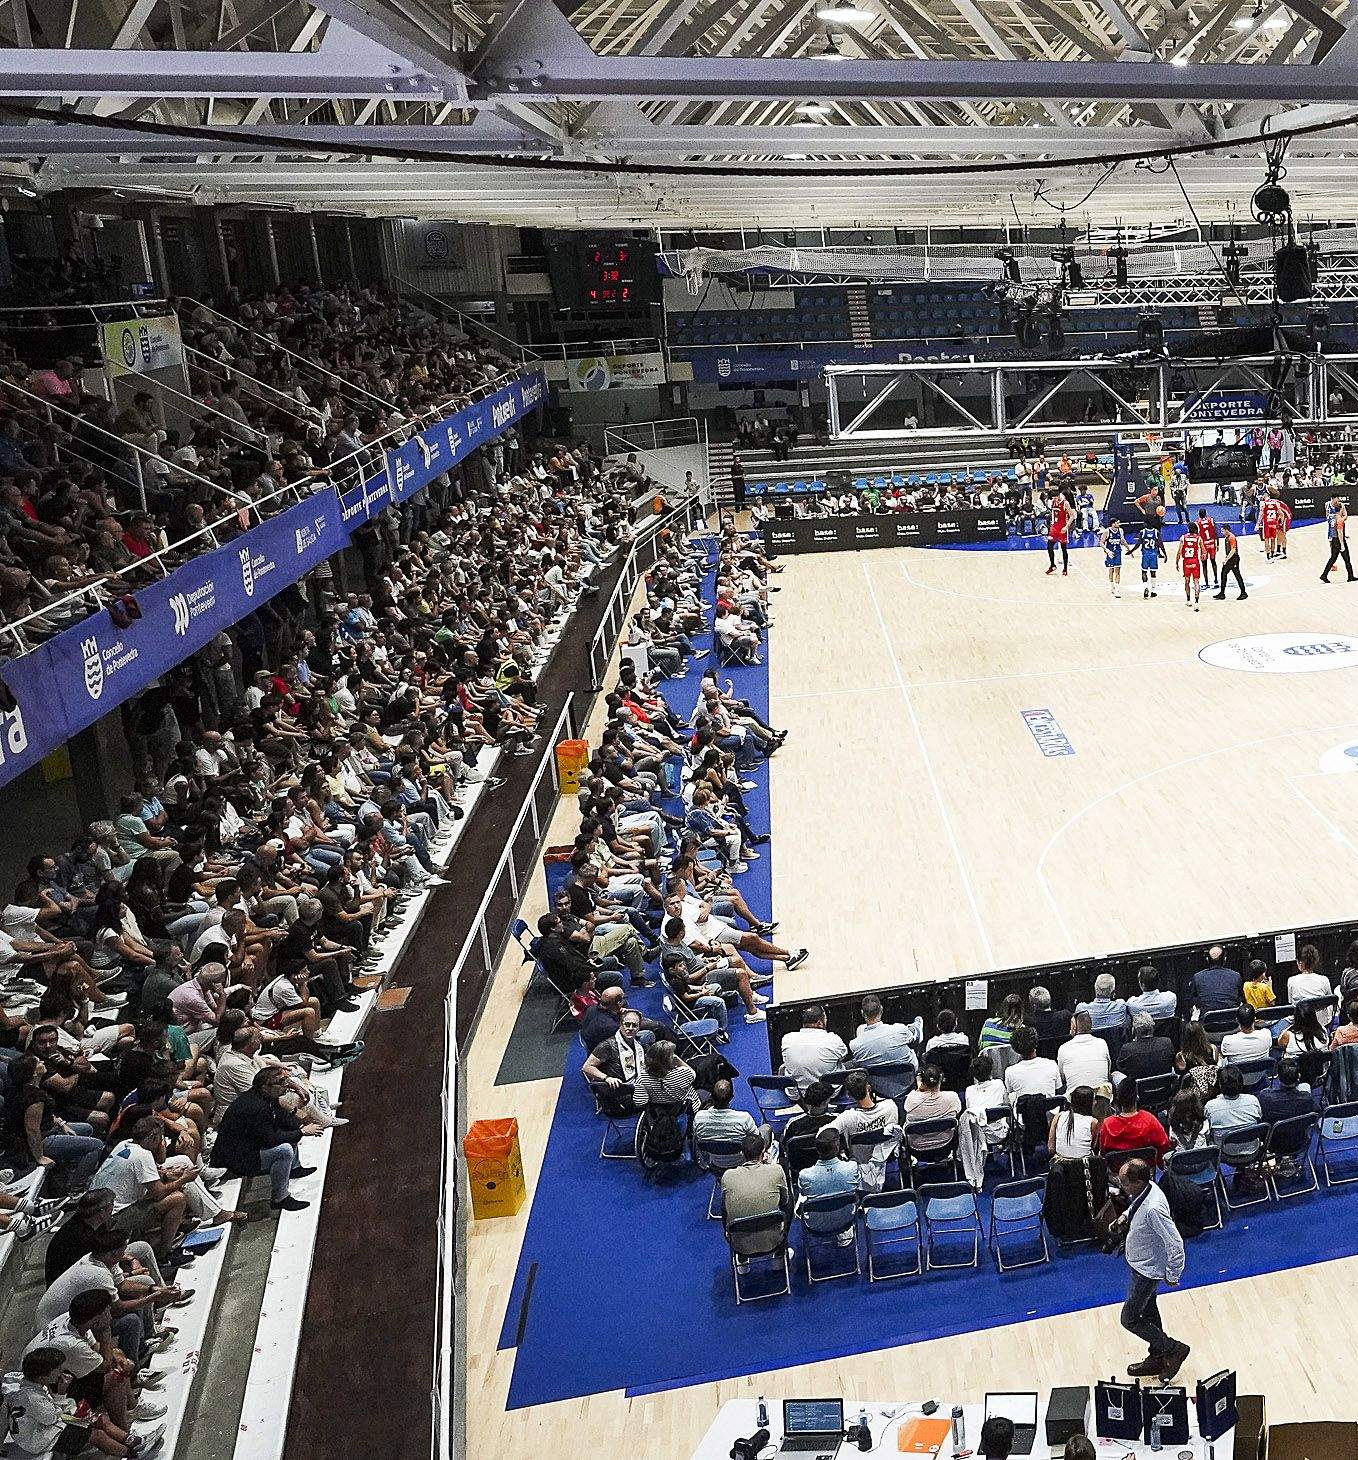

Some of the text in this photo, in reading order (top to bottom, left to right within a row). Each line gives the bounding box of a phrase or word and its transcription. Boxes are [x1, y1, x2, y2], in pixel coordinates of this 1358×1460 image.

[612, 362, 644, 370] DEPORTE
[613, 367, 659, 376] PONTEVEDRA
[1190, 407, 1264, 418] ONTEVEDRA
[1144, 538, 1156, 549] 24
[187, 580, 214, 602] Deputación
[102, 641, 124, 660] Concello
[106, 648, 139, 676] de Pontevedra
